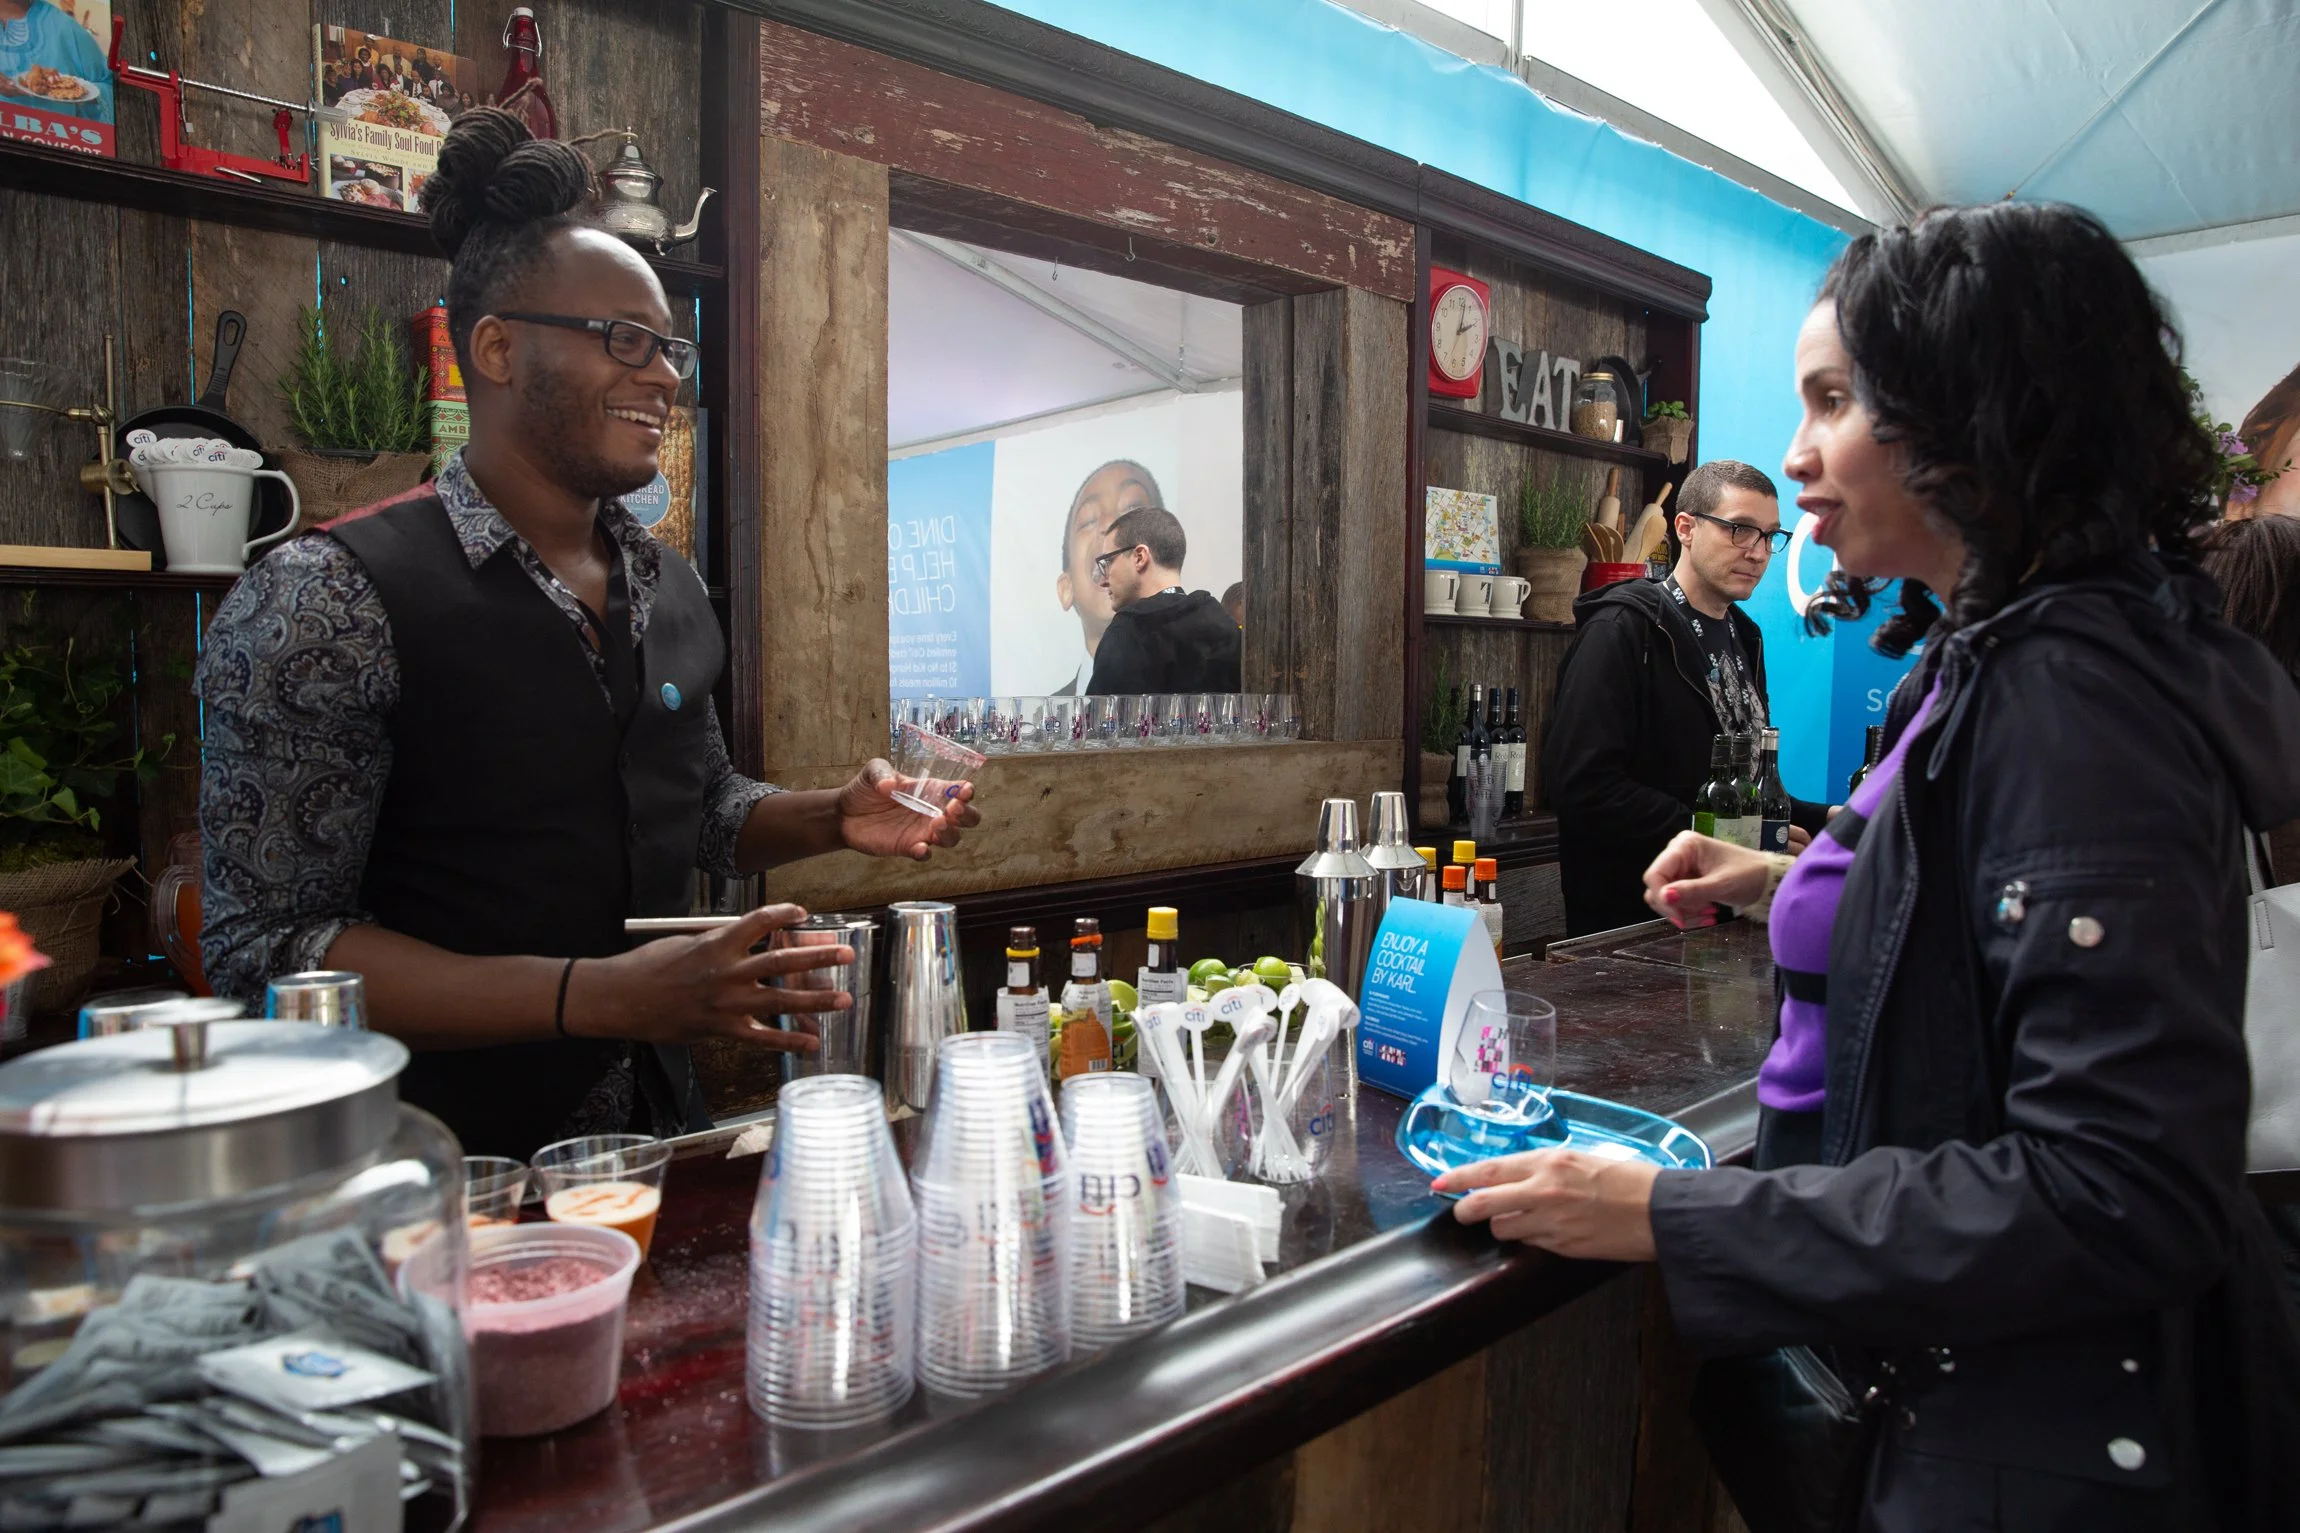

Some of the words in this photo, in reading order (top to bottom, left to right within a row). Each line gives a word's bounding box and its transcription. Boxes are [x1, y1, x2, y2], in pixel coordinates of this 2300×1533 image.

[330, 122, 363, 141] Sylvia's
[365, 126, 392, 151] Family
[394, 131, 412, 153] Soul
[414, 136, 434, 156] Food
[1441, 307, 1448, 318] 10
[1435, 322, 1441, 332] 9
[1474, 334, 1480, 345] 3
[1437, 339, 1442, 349] 8
[1443, 352, 1448, 361] 7
[1451, 358, 1457, 369] 6
[1494, 337, 1580, 434] EAT
[133, 433, 151, 444] citi
[438, 424, 470, 434] AMB
[208, 451, 226, 462] citi
[176, 495, 193, 510] 2
[195, 493, 234, 517] Cups
[619, 493, 659, 505] KITCHEN
[1380, 931, 1421, 953] ENJOY
[1416, 939, 1429, 956] A
[1376, 949, 1425, 976] COCKTAIL
[1371, 967, 1389, 985] BY
[1386, 971, 1416, 994] KARL
[1221, 995, 1243, 1015] citi
[1184, 1009, 1206, 1022] citi
[1491, 1069, 1532, 1093] citi
